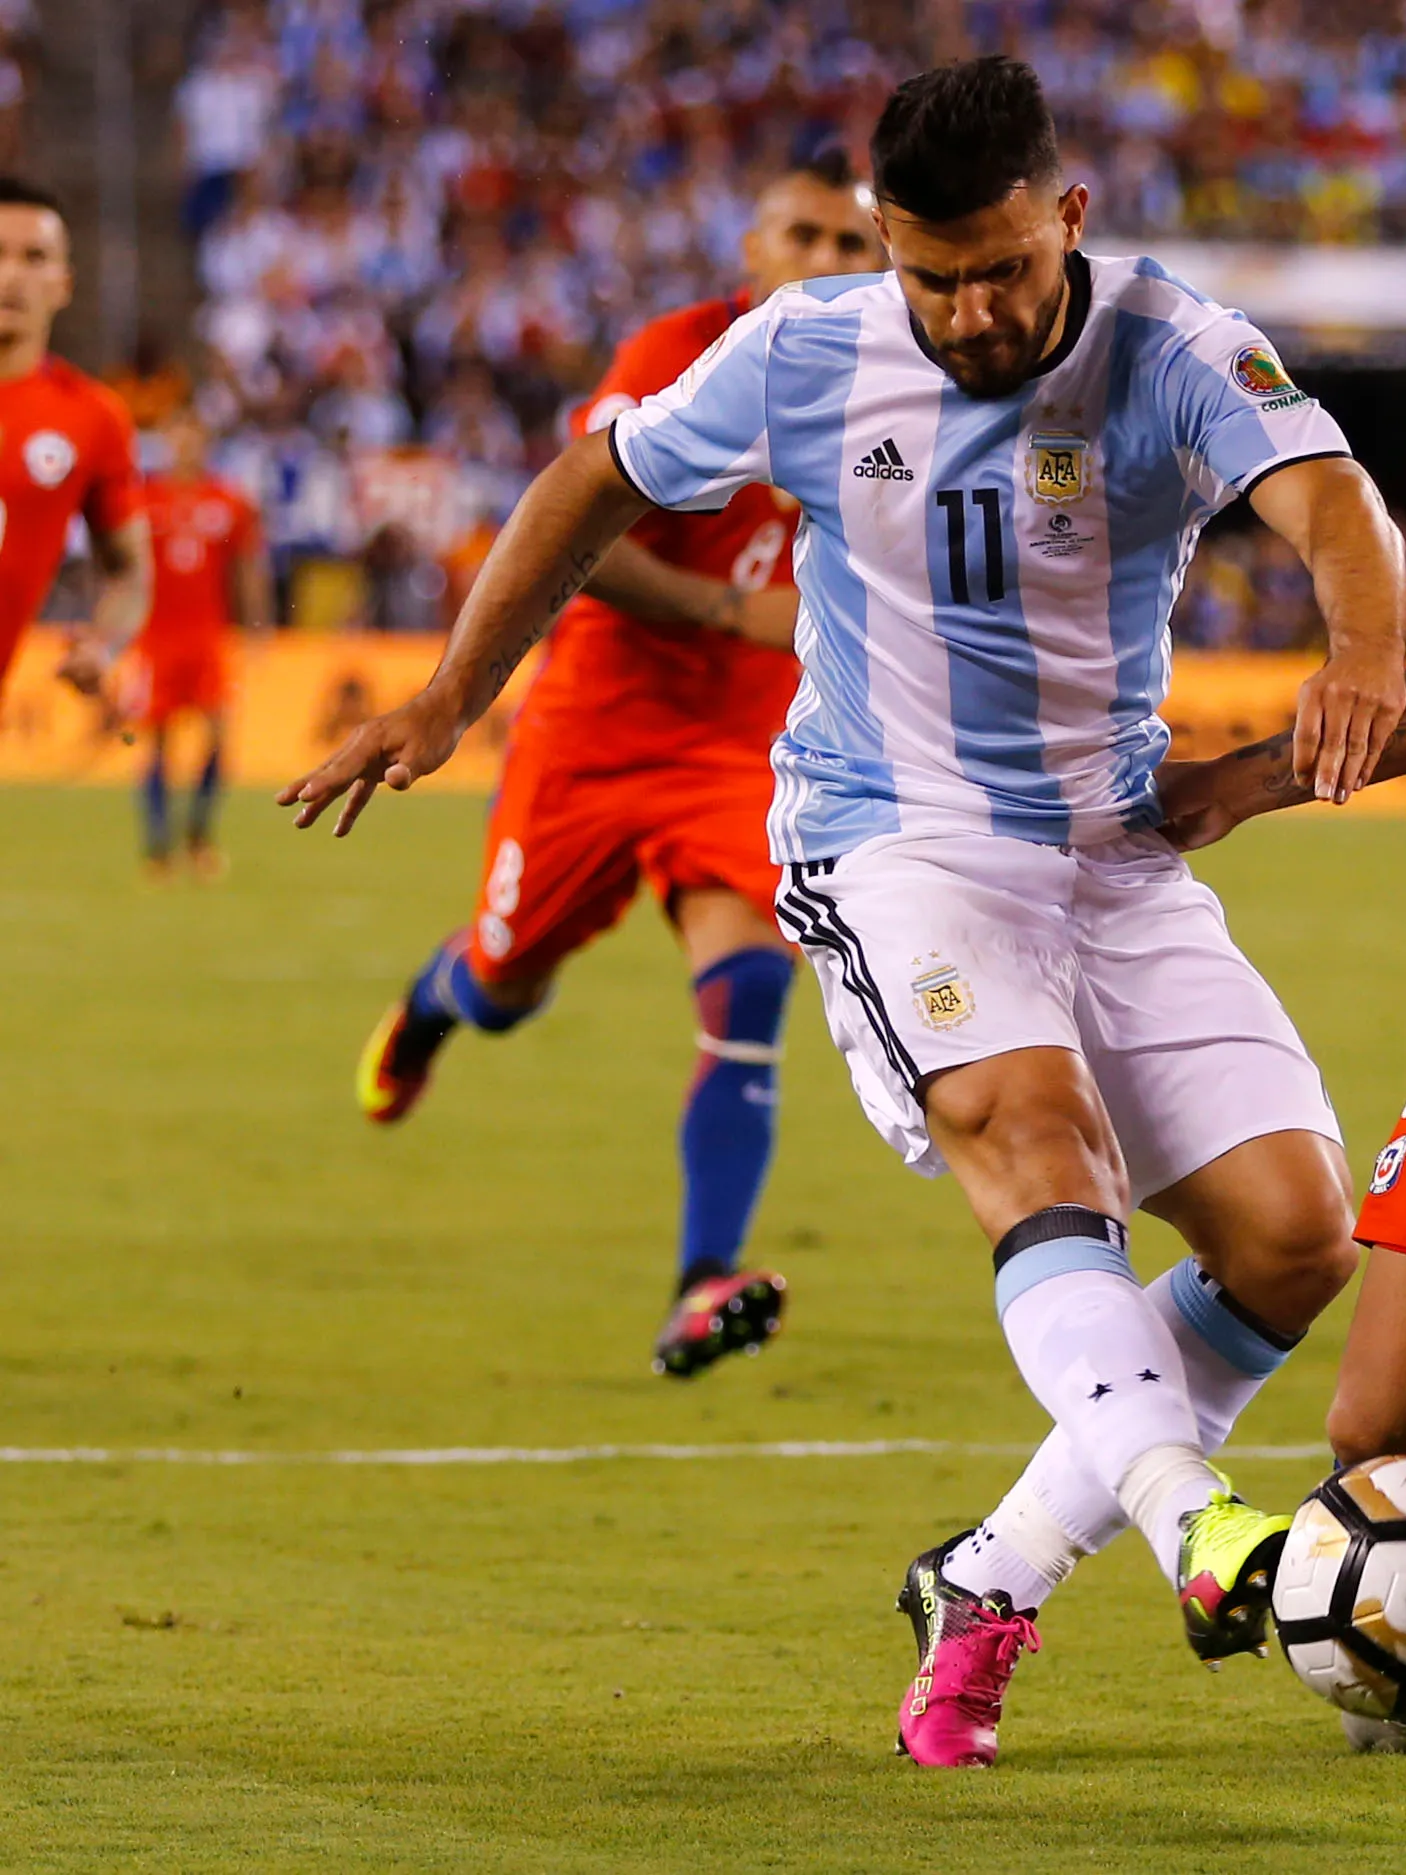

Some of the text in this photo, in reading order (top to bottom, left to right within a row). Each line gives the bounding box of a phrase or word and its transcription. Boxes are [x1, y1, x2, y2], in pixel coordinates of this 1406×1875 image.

[853, 464, 914, 481] adidas
[1039, 450, 1077, 487] AFA
[731, 519, 786, 594] 8
[936, 488, 1005, 604] 11
[929, 984, 961, 1013] AFA
